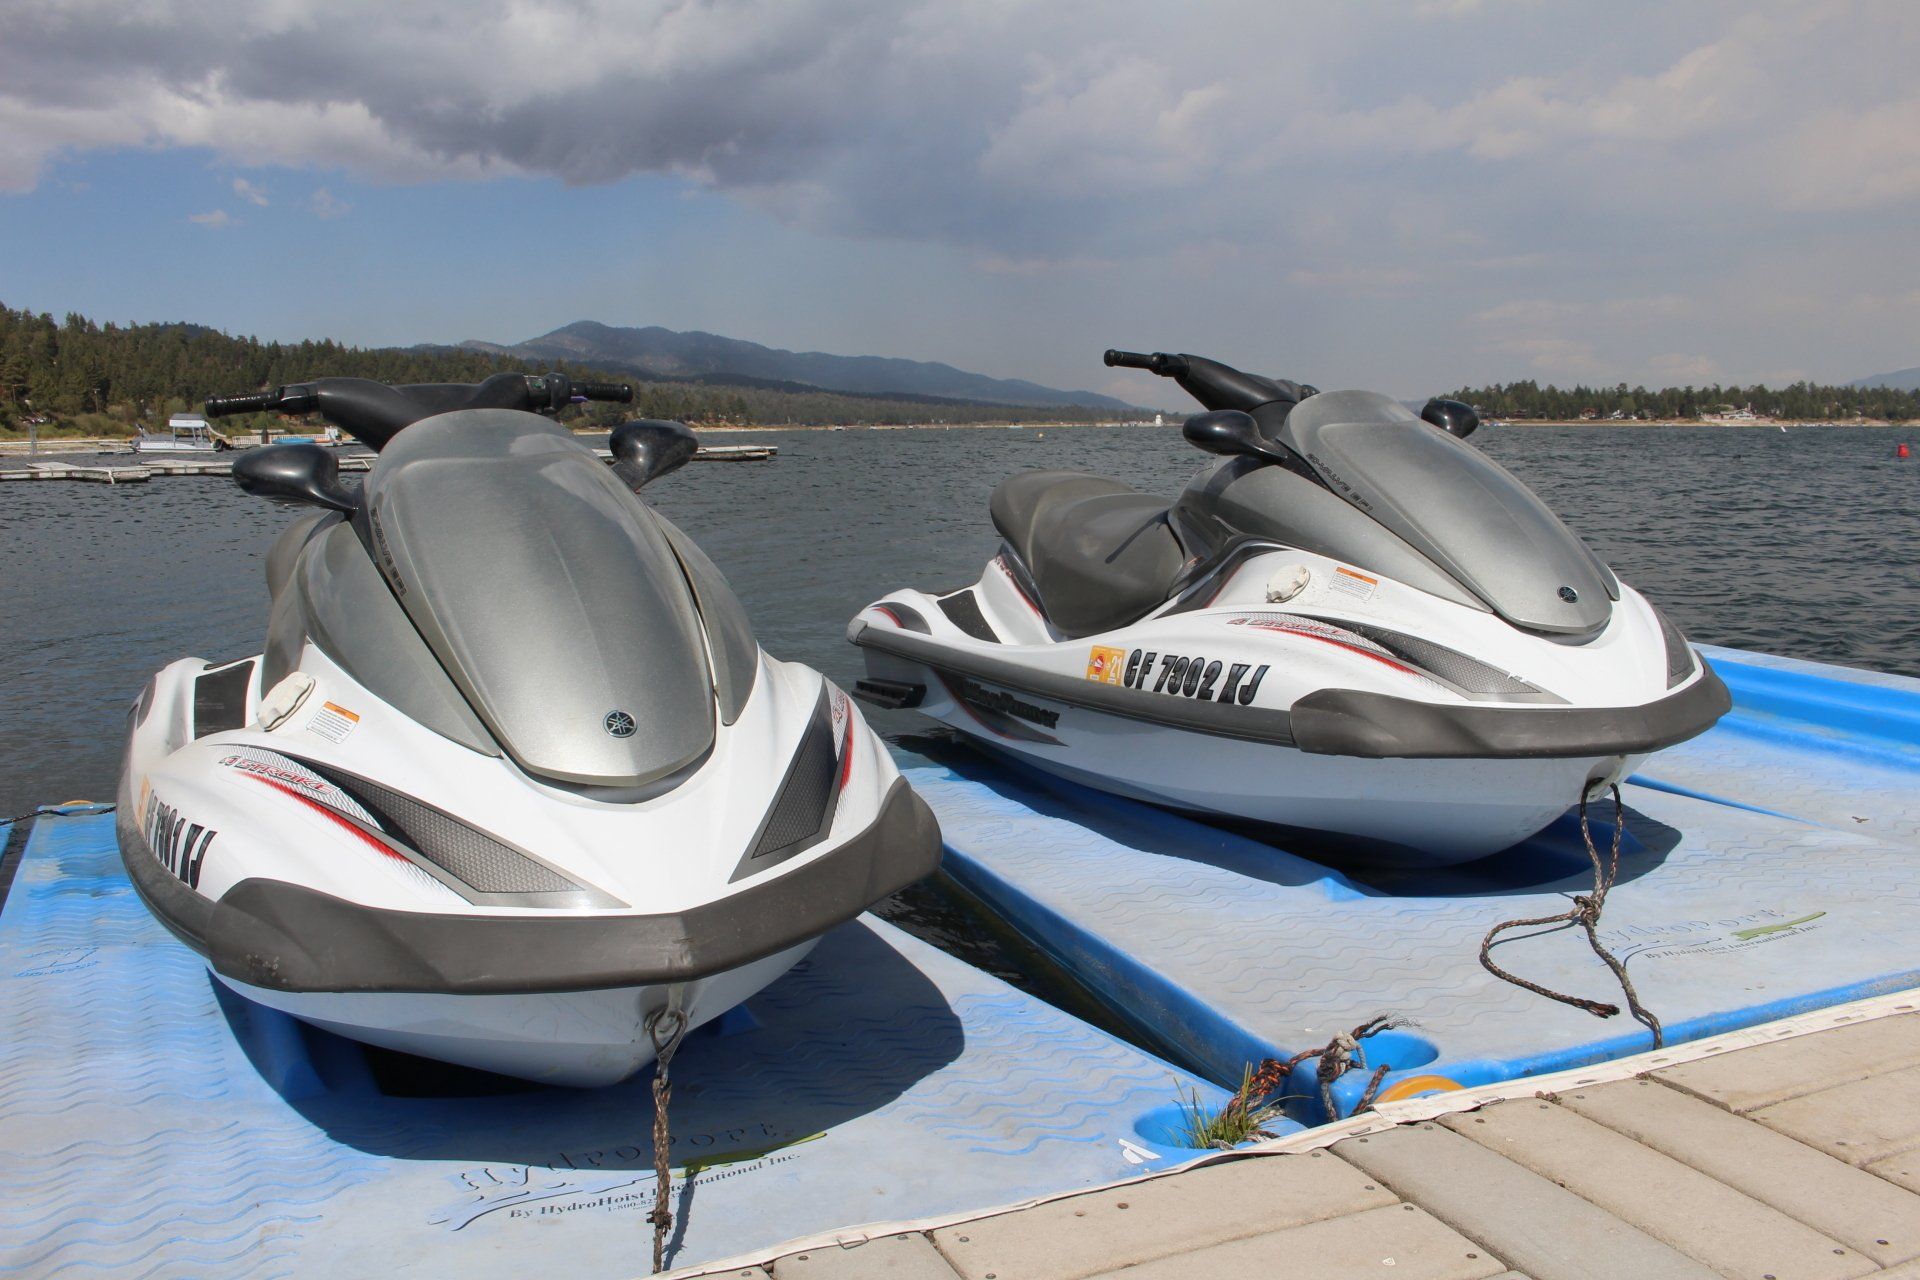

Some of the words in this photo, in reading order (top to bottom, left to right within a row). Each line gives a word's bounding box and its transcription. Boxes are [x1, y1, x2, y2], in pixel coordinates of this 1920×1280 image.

[1123, 648, 1158, 690] CF
[1153, 656, 1223, 701] 7302
[1216, 663, 1271, 706] XJ
[509, 1208, 534, 1219] By
[652, 1159, 763, 1197] Iternational
[769, 1153, 801, 1166] Inc.
